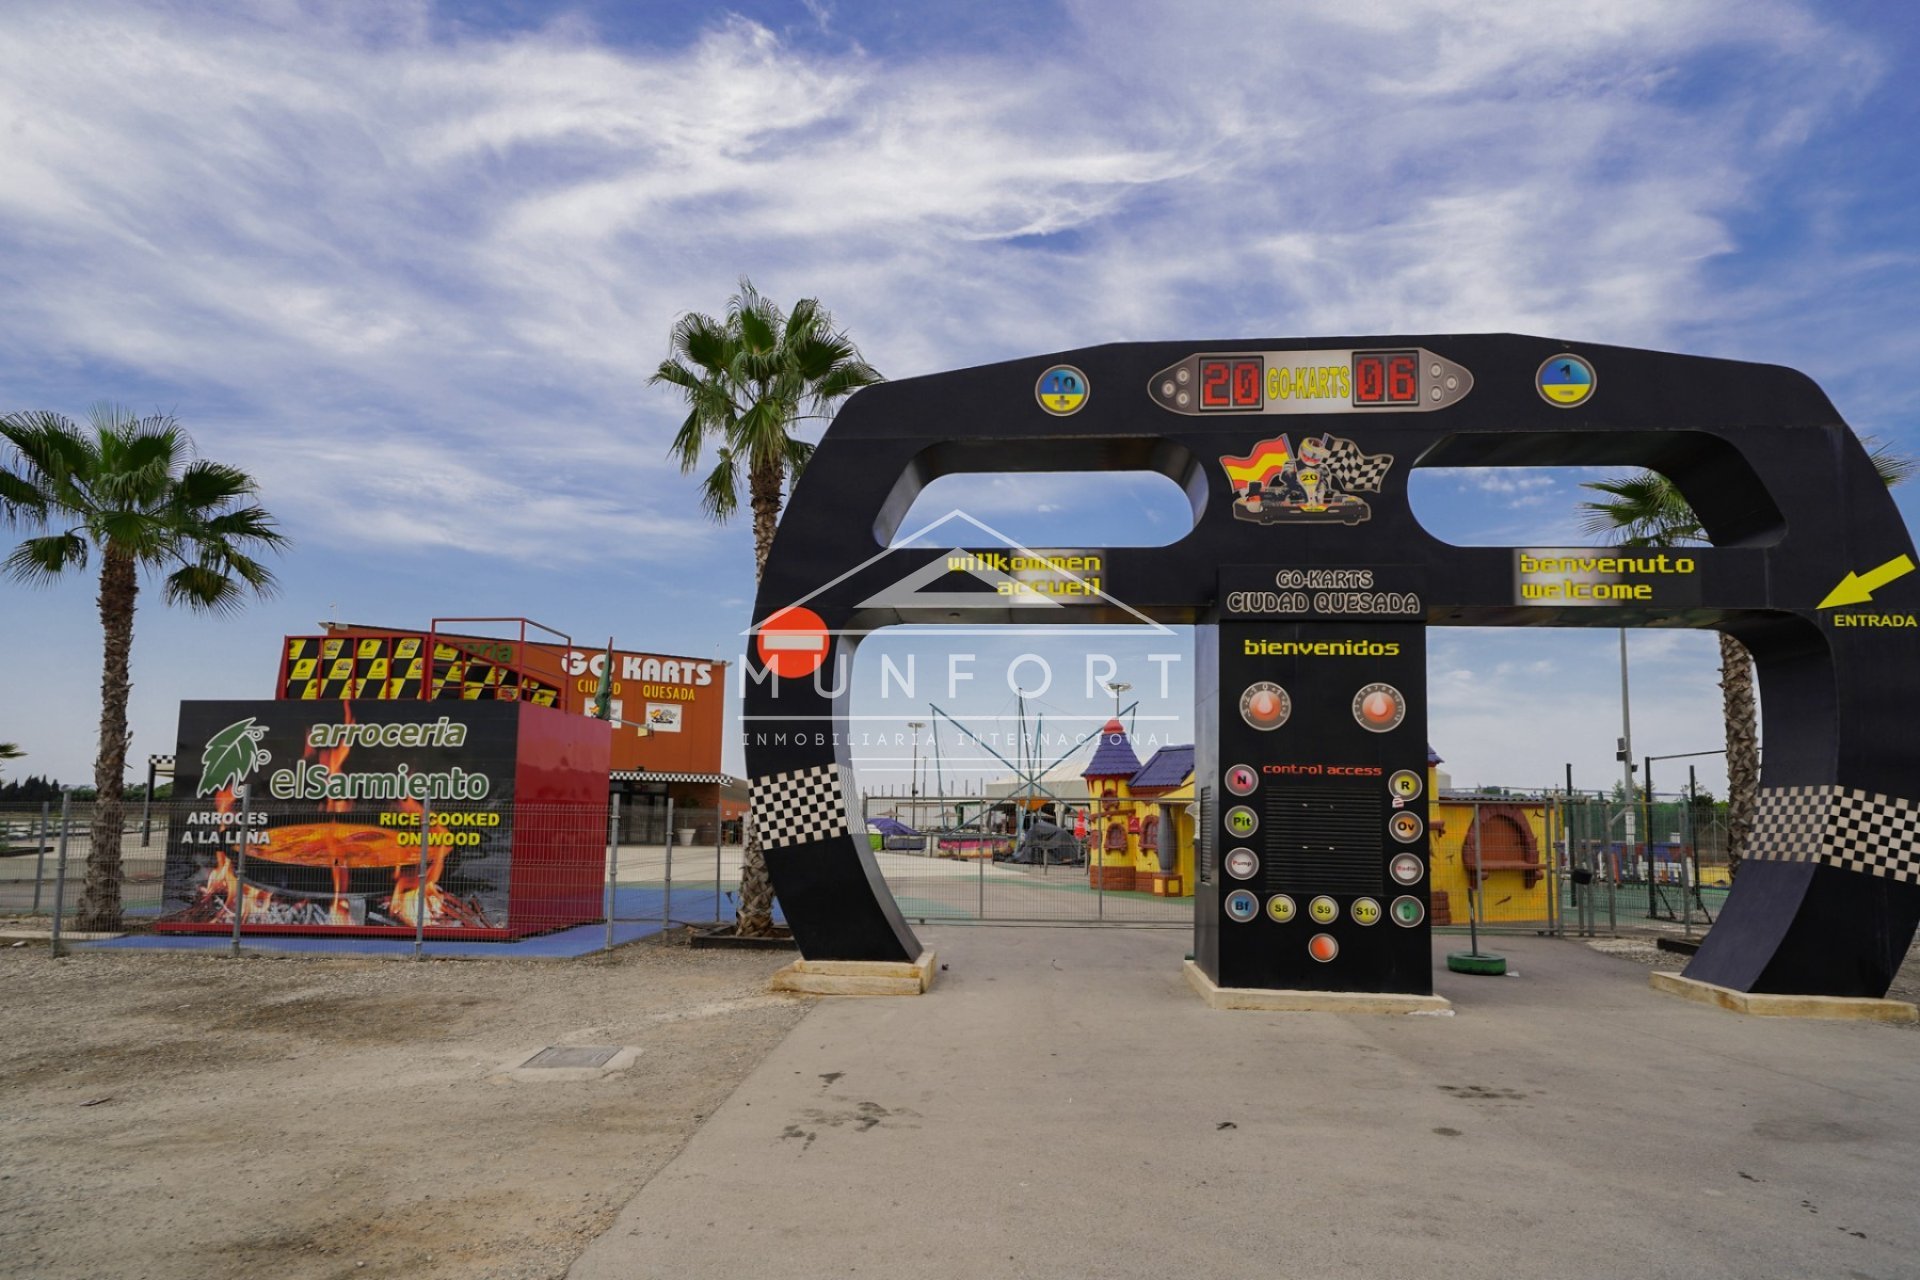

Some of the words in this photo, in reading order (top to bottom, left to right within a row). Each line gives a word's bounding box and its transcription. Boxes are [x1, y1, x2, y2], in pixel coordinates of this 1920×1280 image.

[1203, 362, 1259, 406] 20
[1266, 366, 1350, 400] GO-KARTS
[1357, 356, 1416, 401] 06
[948, 552, 1102, 571] willkommen
[1520, 554, 1695, 574] benvenuto
[997, 577, 1101, 597] accueil
[1276, 569, 1374, 589] GO-KARTS
[1521, 579, 1653, 600] welcome
[1227, 592, 1309, 612] CIUDAD
[1314, 592, 1420, 614] QUESADA
[1834, 614, 1918, 627] ENTRADA
[1244, 639, 1400, 656] bienvenidos
[561, 651, 615, 676] GO
[622, 656, 712, 686] KARTS
[577, 679, 621, 695] CIUD
[643, 684, 695, 701] QUESADA
[308, 717, 467, 748] arroceria
[1262, 764, 1323, 775] control
[1327, 766, 1383, 776] access
[1237, 775, 1247, 785] N
[1401, 781, 1410, 790] R
[187, 812, 269, 825] ARROCES
[380, 812, 421, 826] RICE
[428, 812, 500, 826] COOKED
[1397, 822, 1415, 831] Ov
[181, 831, 194, 844] A
[198, 831, 220, 844] LA
[397, 832, 422, 845] ON
[427, 832, 480, 846] WOOD
[1316, 906, 1331, 914] S9
[1356, 907, 1377, 916] S10
